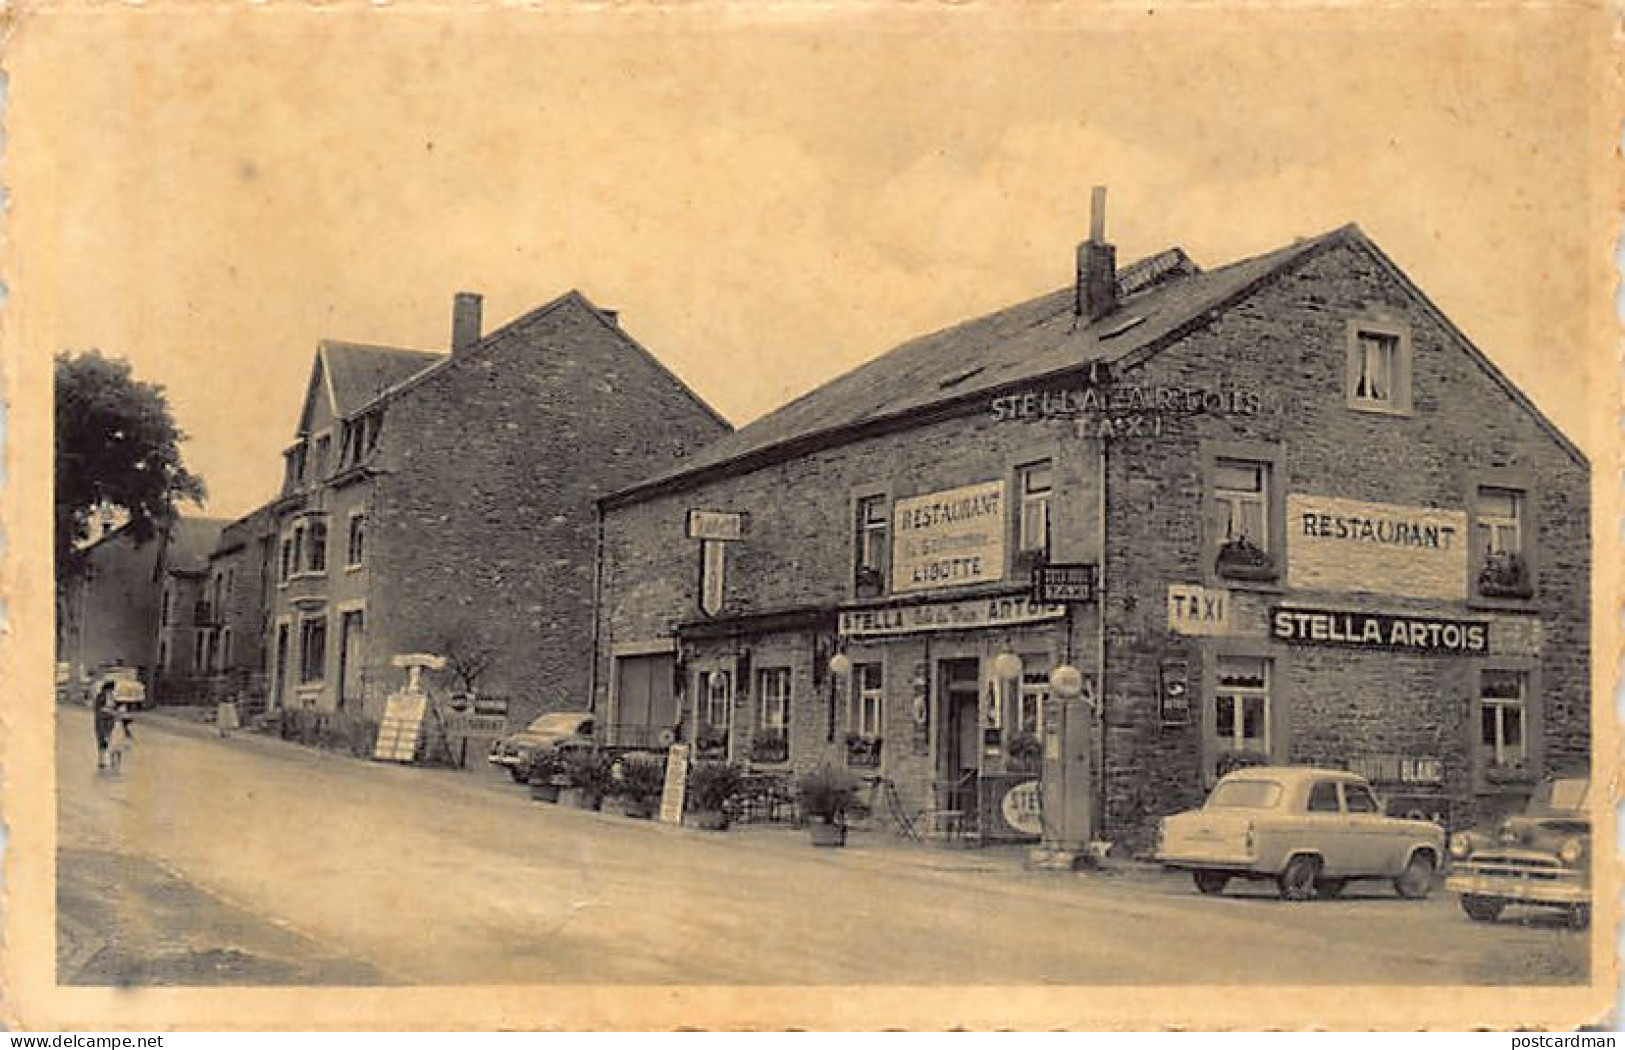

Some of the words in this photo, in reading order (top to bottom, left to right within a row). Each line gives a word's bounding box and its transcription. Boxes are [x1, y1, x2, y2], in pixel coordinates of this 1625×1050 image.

[1075, 415, 1163, 439] TAXI
[902, 491, 1000, 530] RESTAURANT
[1302, 512, 1455, 549] RESTAURANT
[841, 611, 903, 632] STELLA
[1172, 595, 1223, 621] TAXI
[1274, 612, 1382, 643] STELLA
[1389, 620, 1485, 650] ARTOIS
